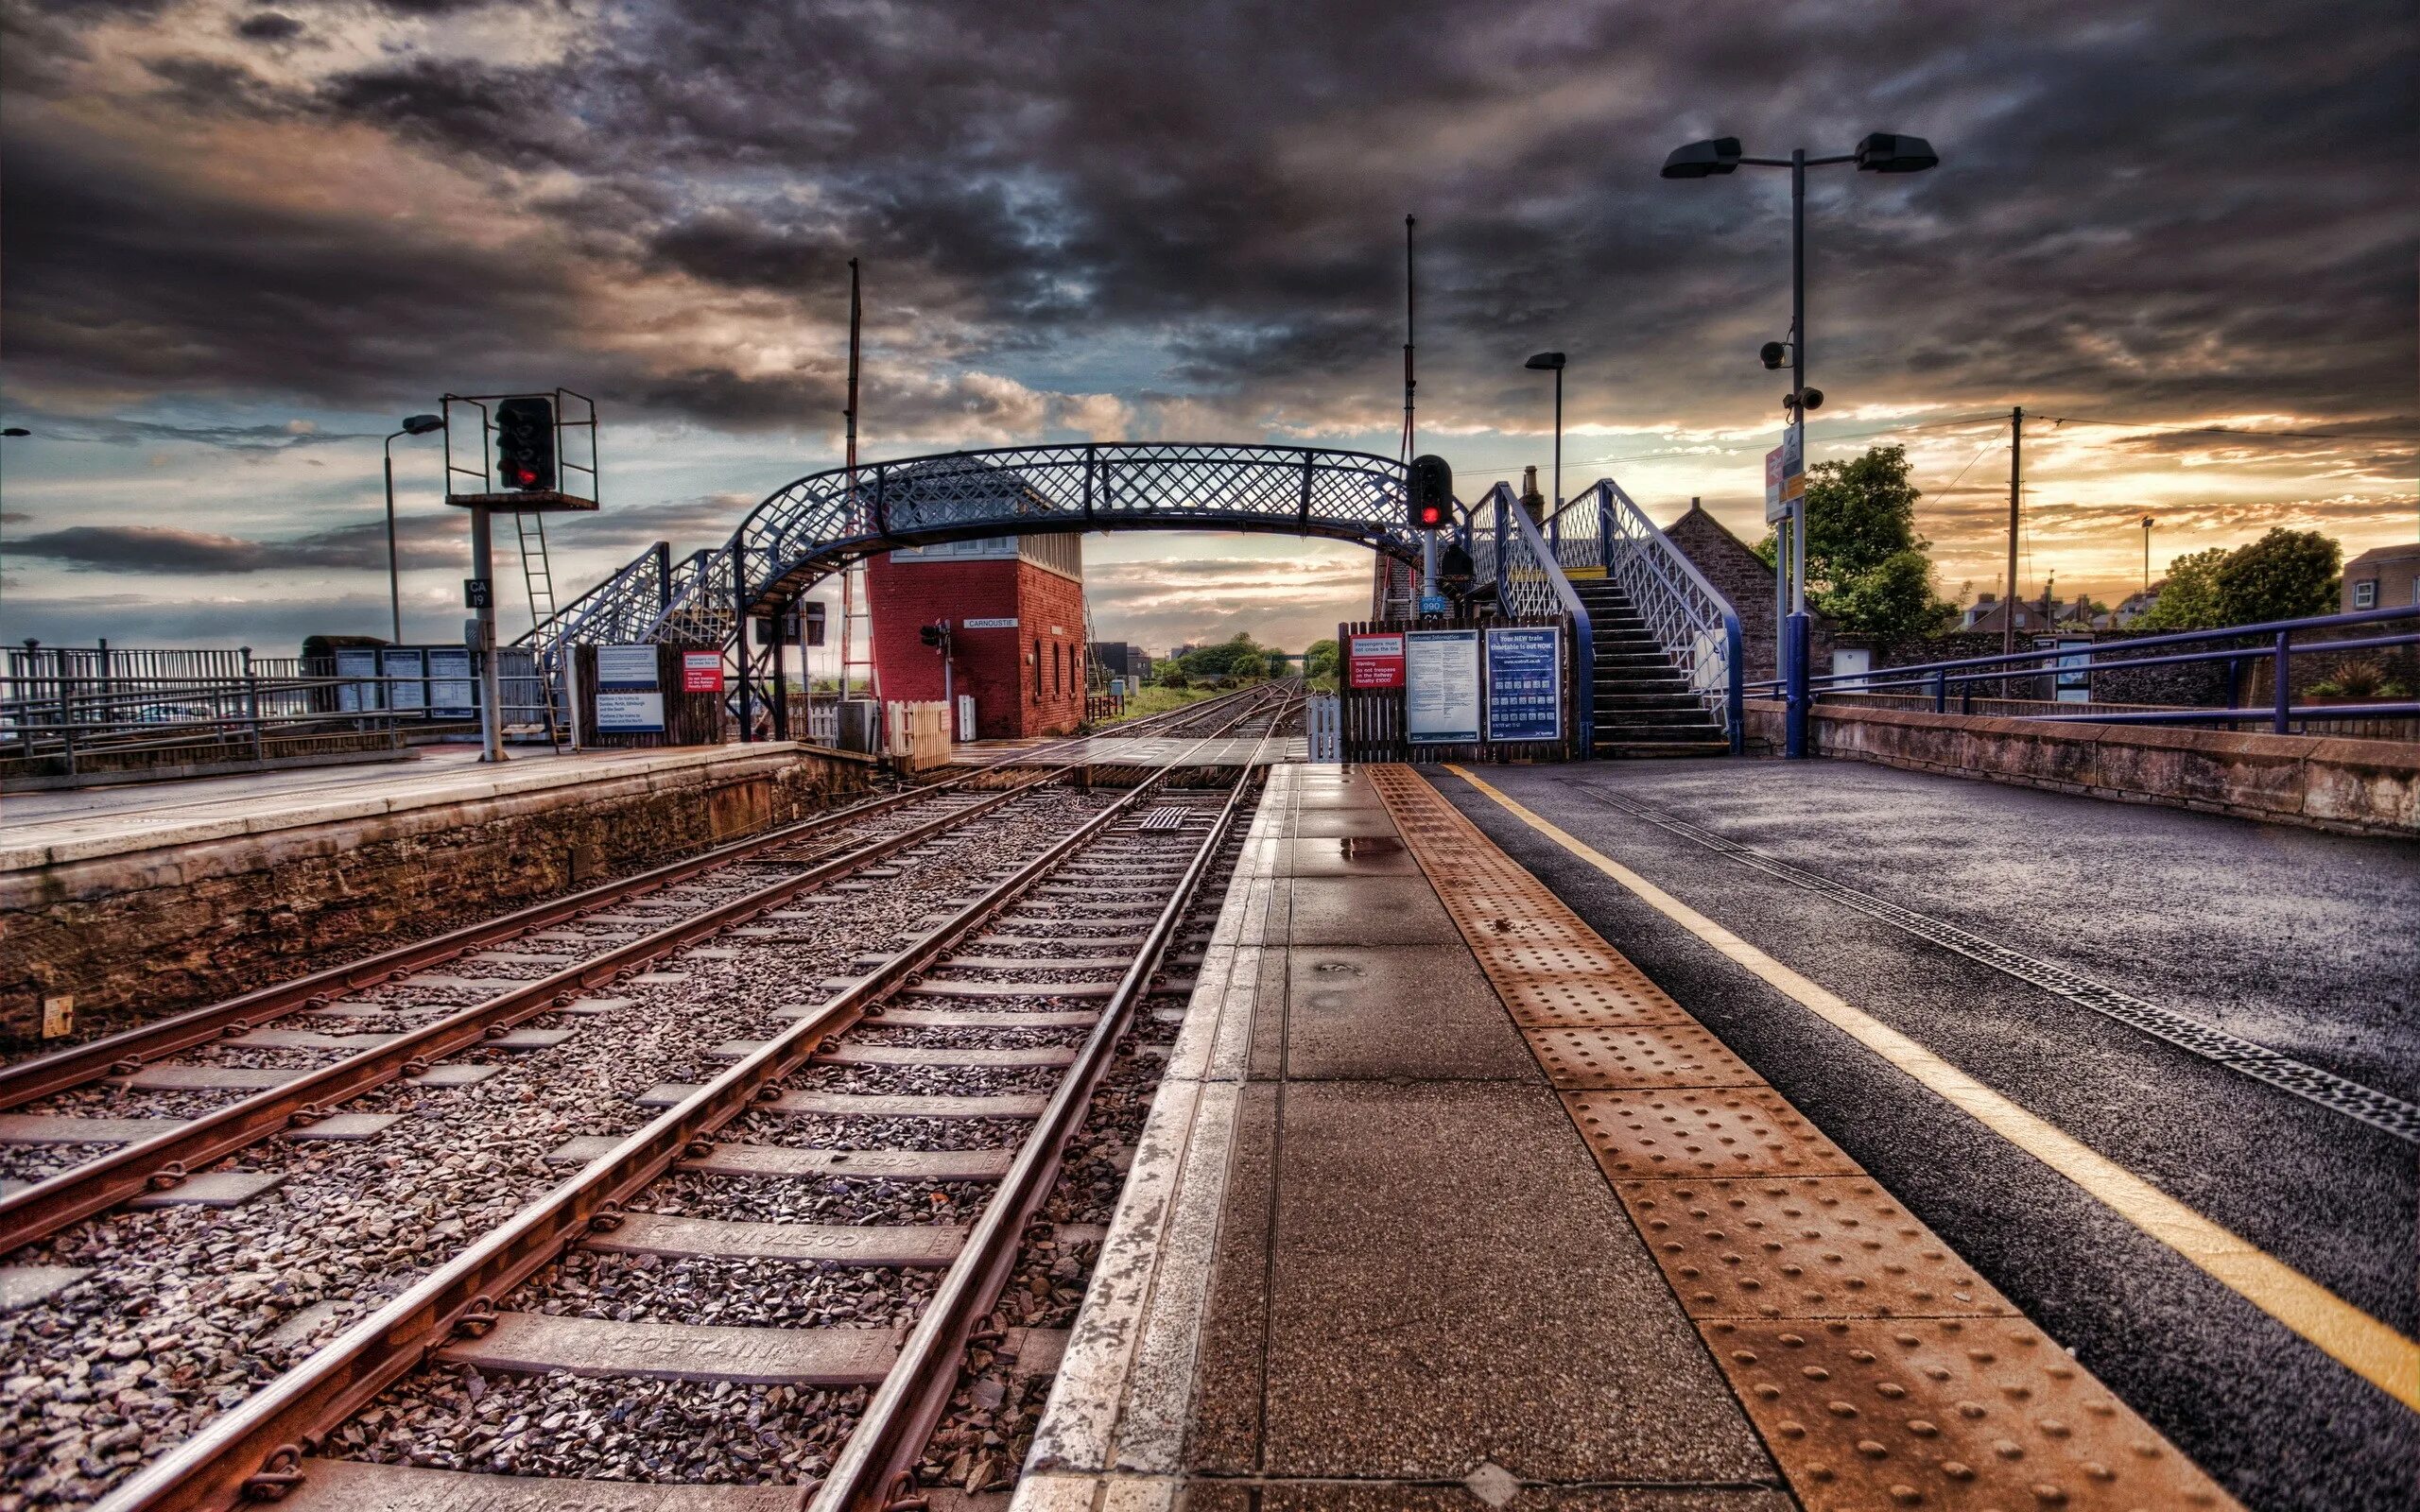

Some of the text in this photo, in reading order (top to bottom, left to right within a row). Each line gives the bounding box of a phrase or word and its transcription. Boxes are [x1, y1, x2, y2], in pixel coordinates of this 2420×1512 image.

[470, 581, 487, 593] CA
[474, 594, 484, 606] 19
[1424, 602, 1441, 610] 990
[716, 1227, 859, 1247] COSTAIN
